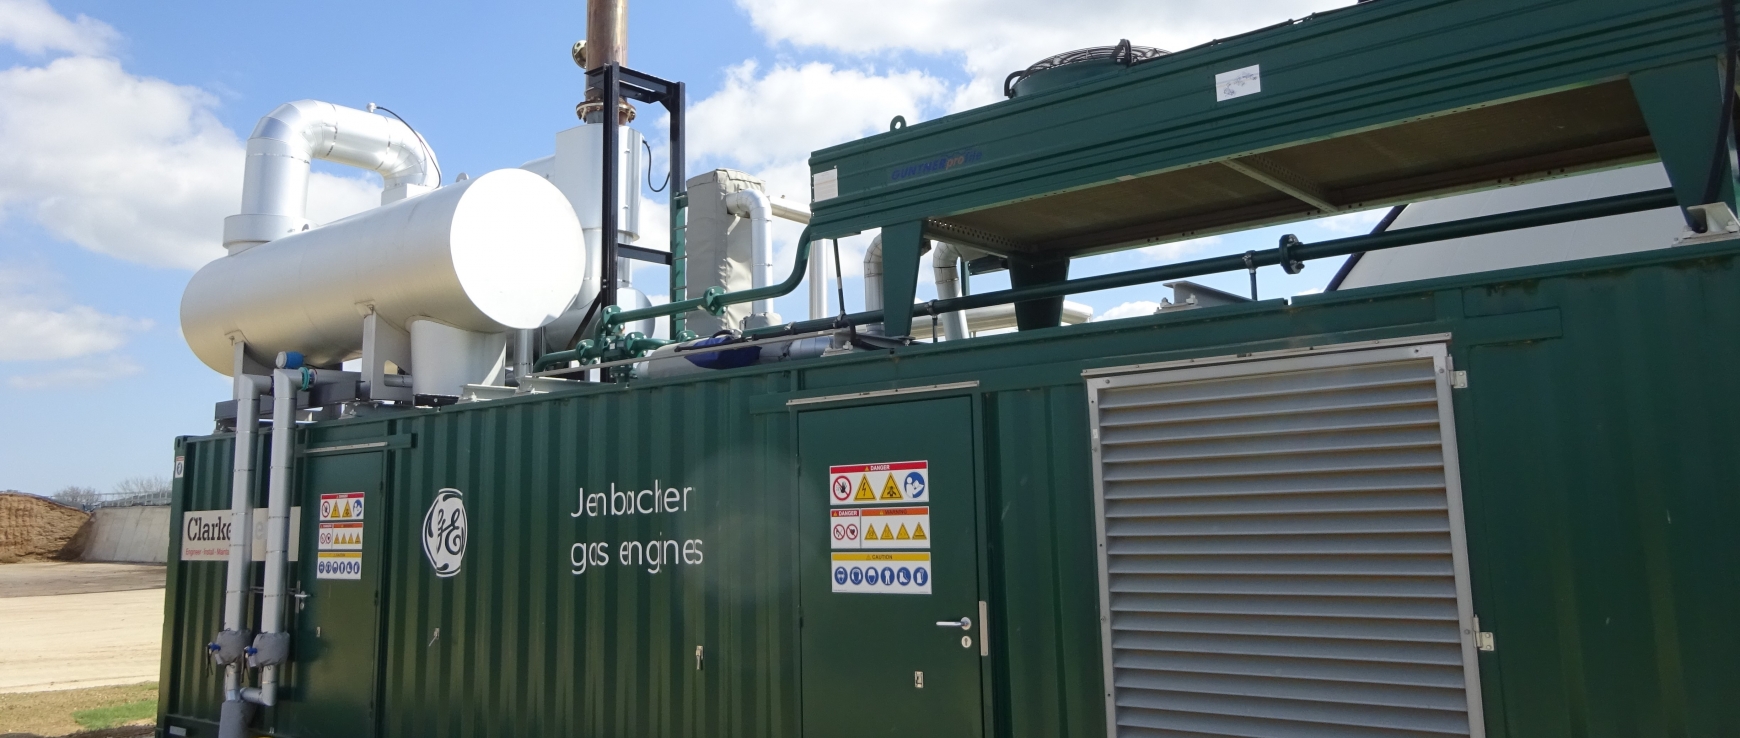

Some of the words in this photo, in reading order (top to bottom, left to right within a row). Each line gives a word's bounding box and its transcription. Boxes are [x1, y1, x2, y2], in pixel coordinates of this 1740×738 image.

[571, 479, 696, 518] Jenbacher
[185, 548, 202, 557] Engineer
[570, 541, 609, 575] gas
[619, 531, 704, 574] engines
